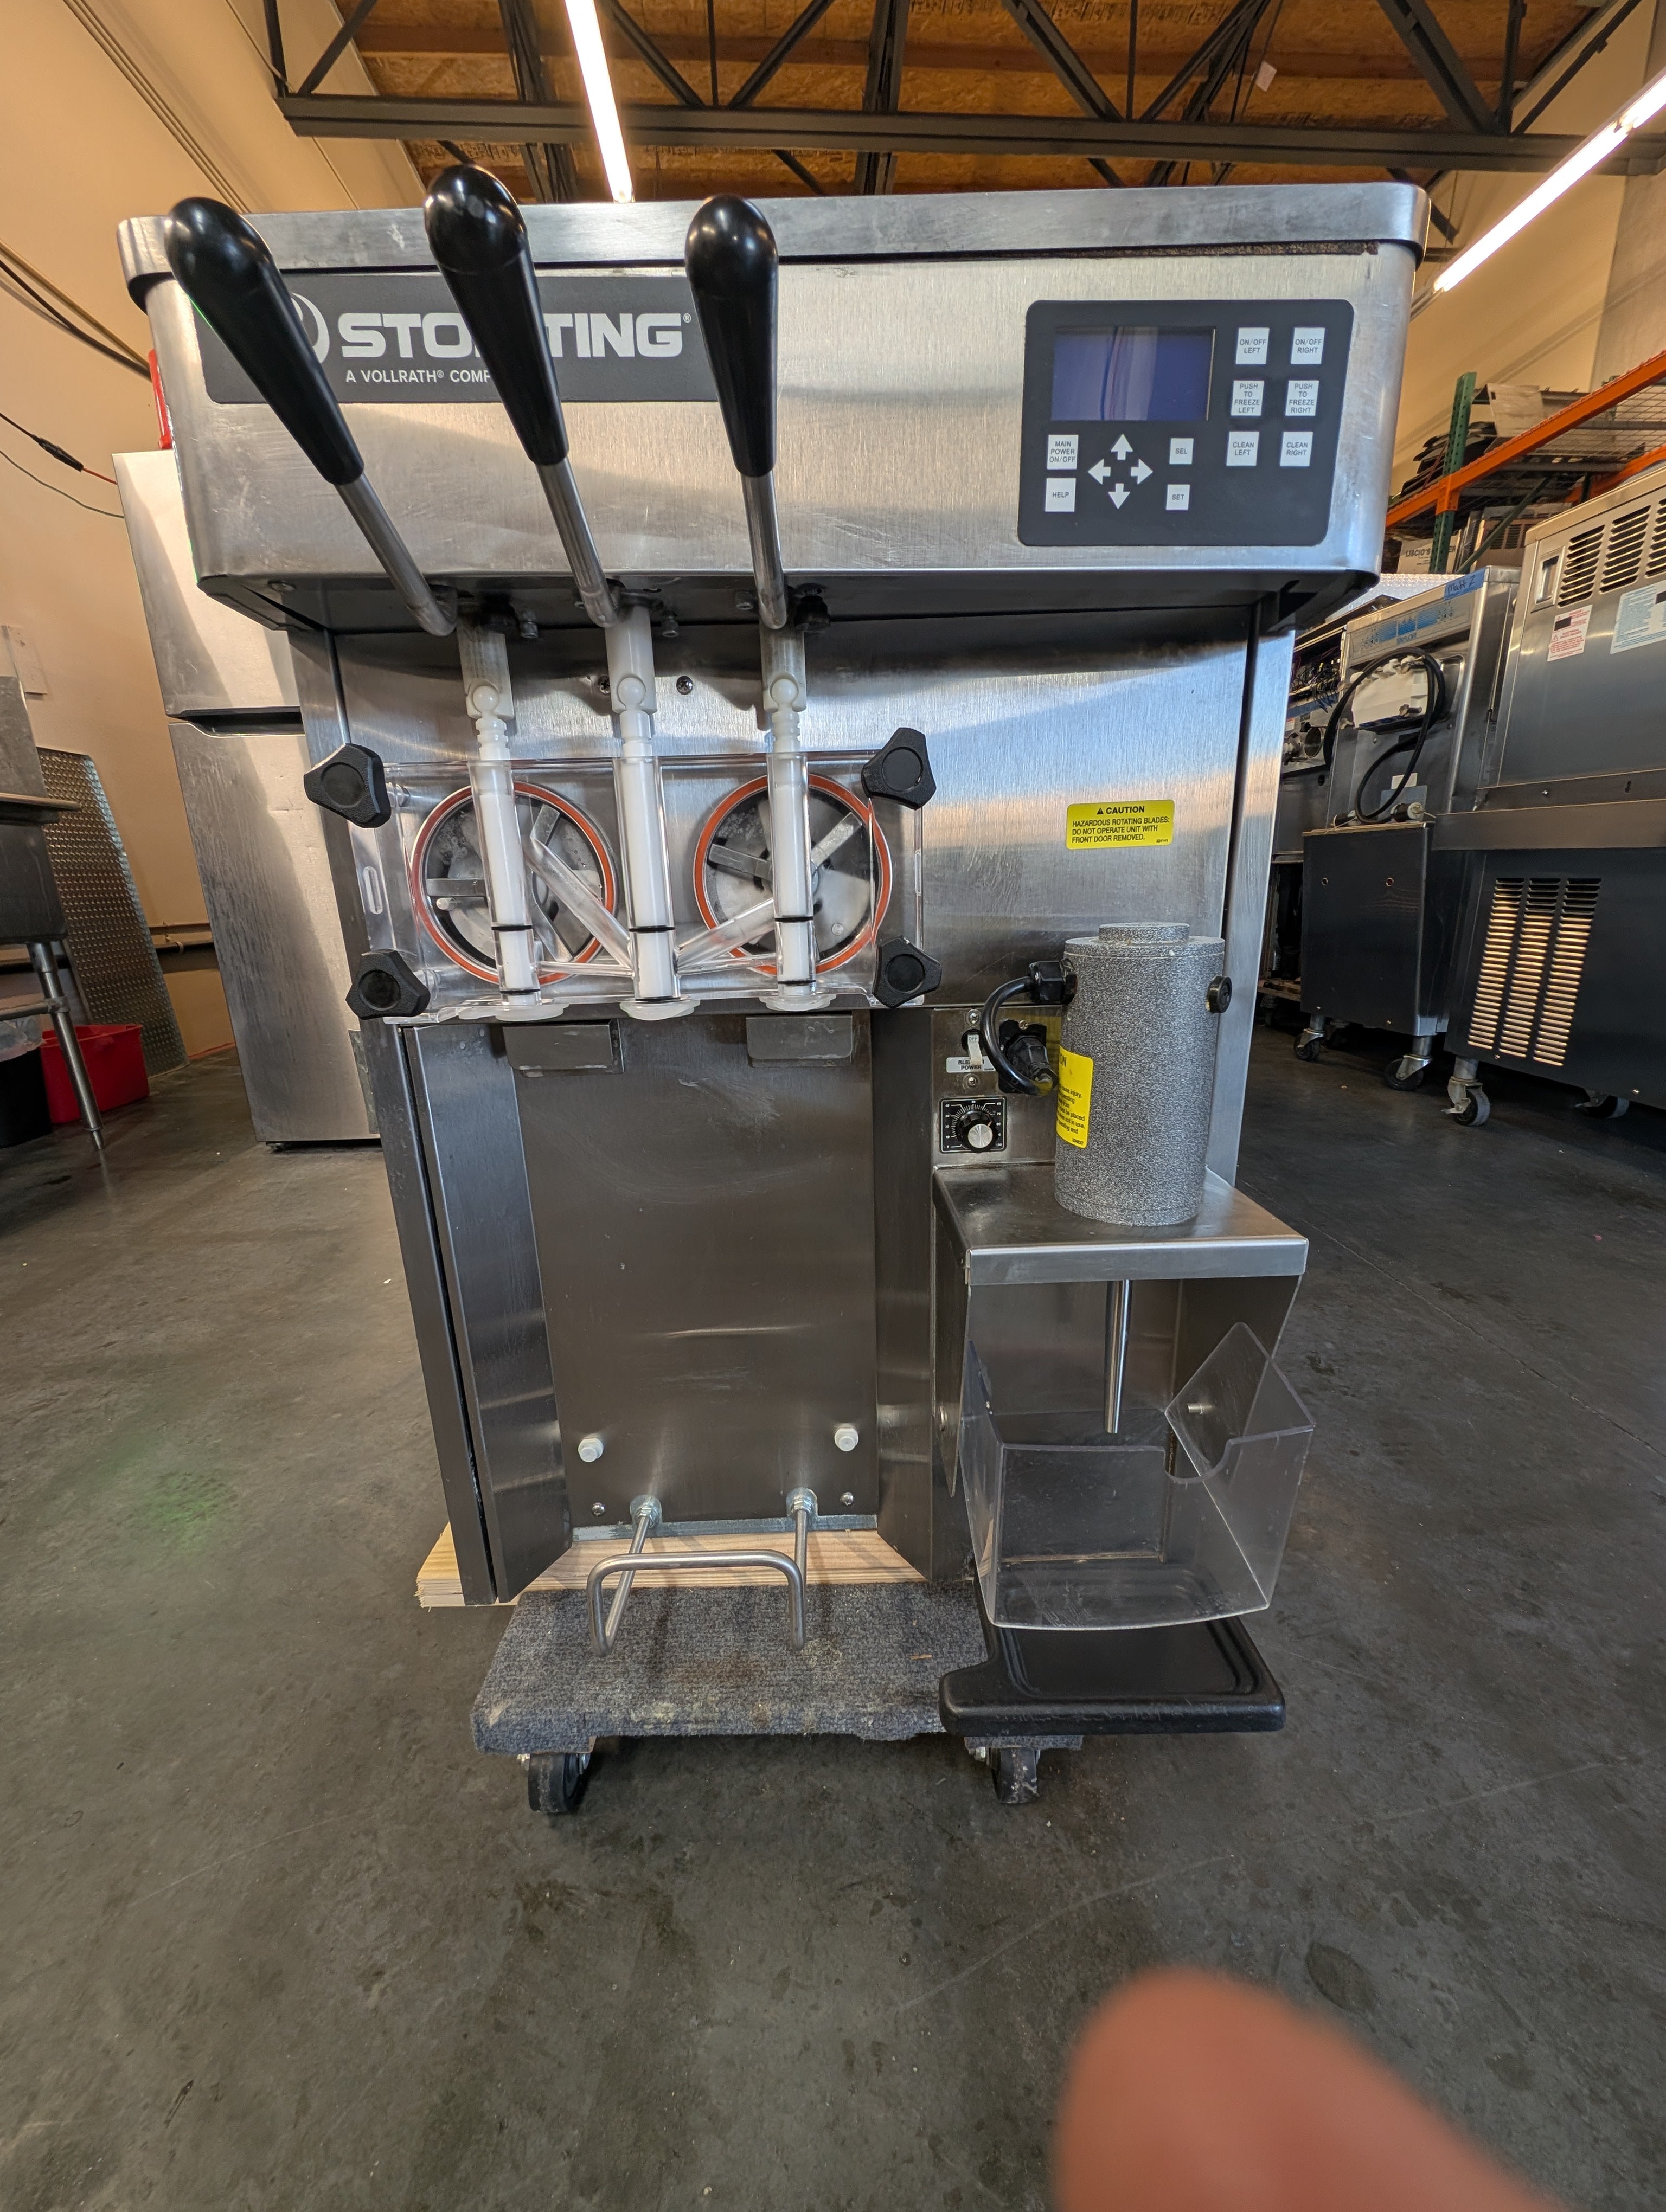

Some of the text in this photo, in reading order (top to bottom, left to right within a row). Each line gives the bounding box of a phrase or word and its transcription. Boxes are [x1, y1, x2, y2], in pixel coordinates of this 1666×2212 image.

[338, 313, 691, 358] STOTING®
[345, 370, 356, 383] A
[1106, 806, 1145, 814] CAUTION
[1072, 819, 1111, 827] HAZARDOUS
[1112, 818, 1142, 826] ROTATING
[1097, 826, 1125, 834] OPERATE
[1113, 833, 1145, 841] REMOVED.
